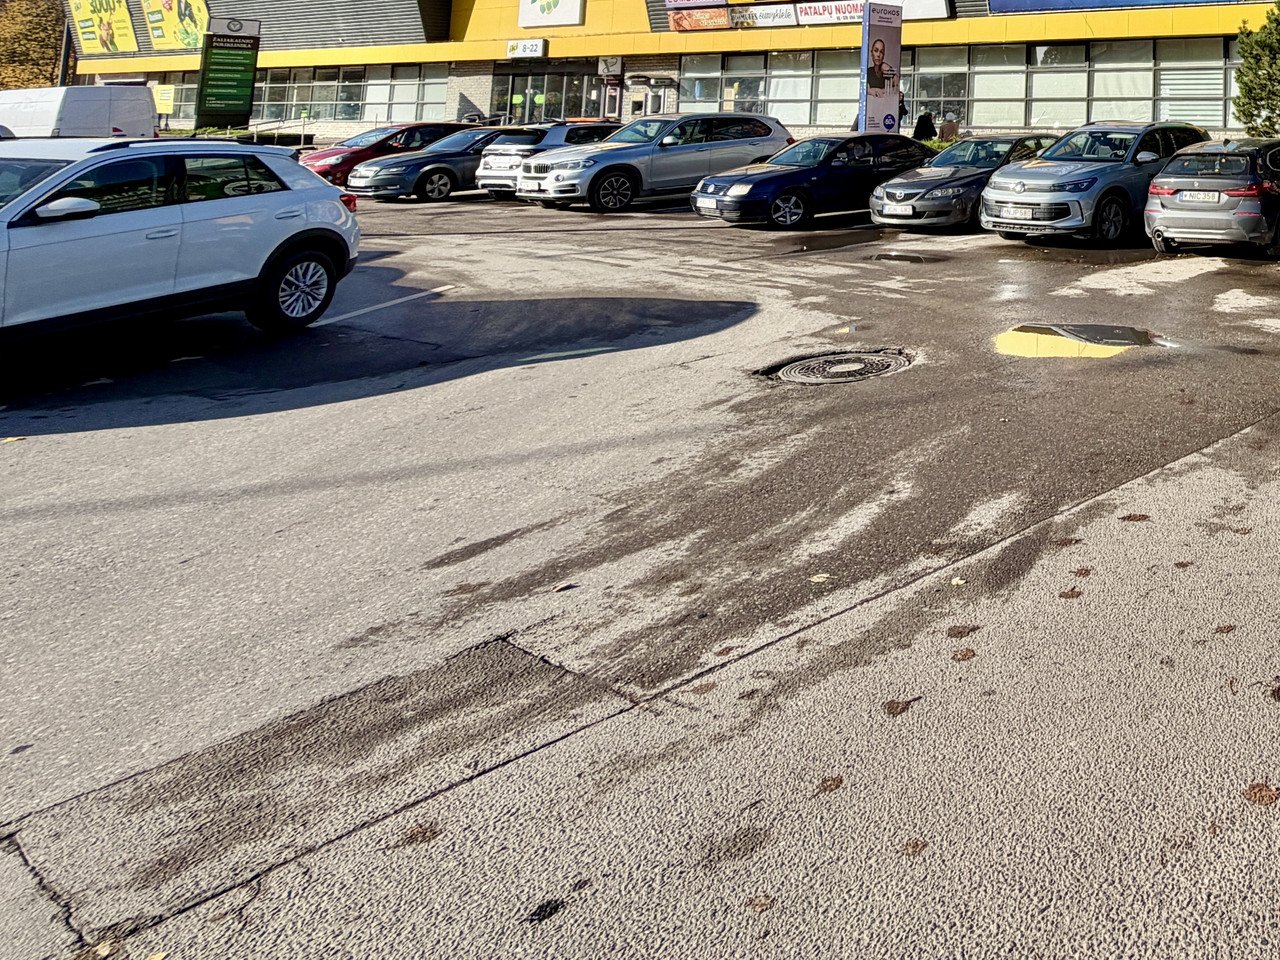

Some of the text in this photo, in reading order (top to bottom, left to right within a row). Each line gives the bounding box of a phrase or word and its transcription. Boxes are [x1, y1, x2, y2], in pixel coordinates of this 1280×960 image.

[799, 4, 833, 19] PATALPŲ
[835, 2, 864, 14] NUOMA
[871, 7, 900, 17] eurokos
[522, 43, 538, 53] 8-22
